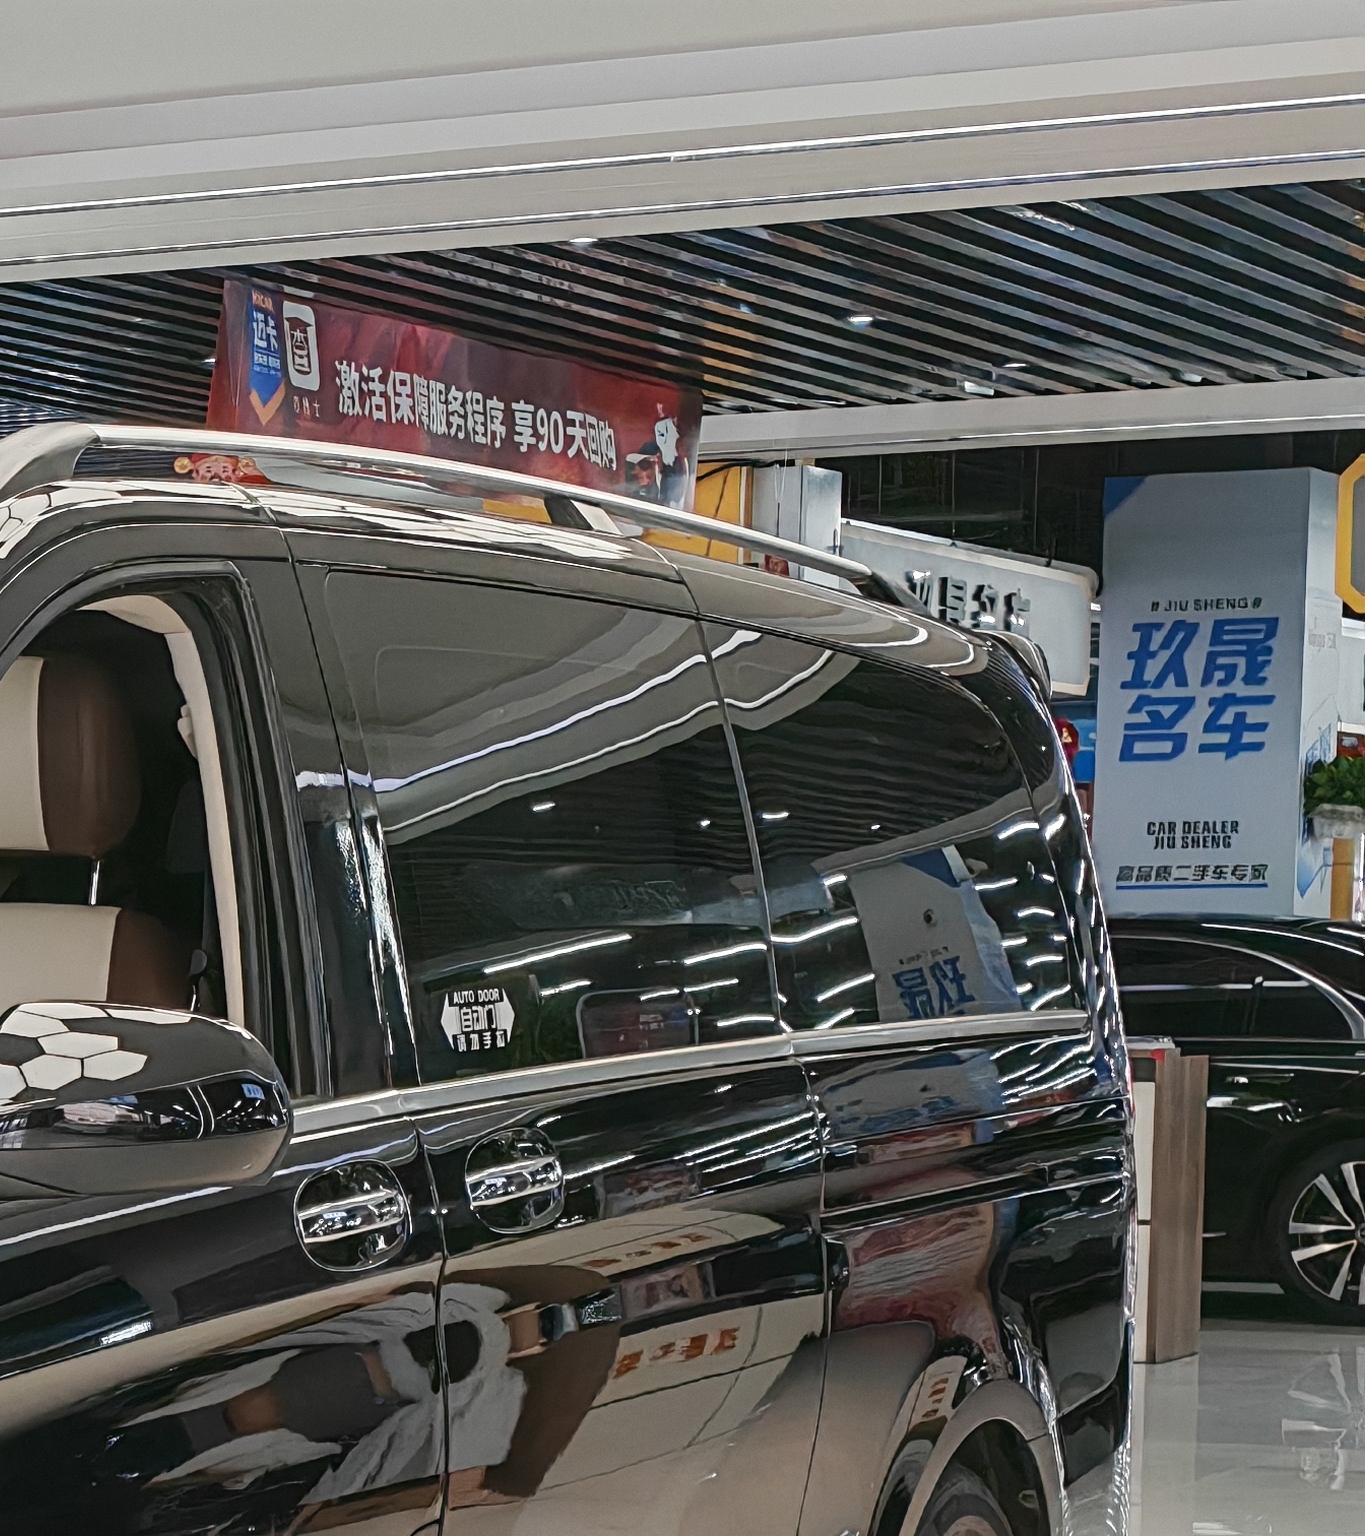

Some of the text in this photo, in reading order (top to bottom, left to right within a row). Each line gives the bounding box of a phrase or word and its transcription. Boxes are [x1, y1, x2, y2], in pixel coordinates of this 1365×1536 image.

[334, 359, 617, 471] 激活保障服务程序 享90天回购
[1193, 597, 1249, 612] SHENG
[1120, 616, 1280, 690] 玖晟
[1119, 692, 1277, 763] 名车
[1146, 820, 1240, 836] CAR DEALER
[1154, 835, 1233, 850] JIU SHENG
[453, 988, 501, 1005] AUTO DOOR
[460, 1004, 497, 1032] 自动门
